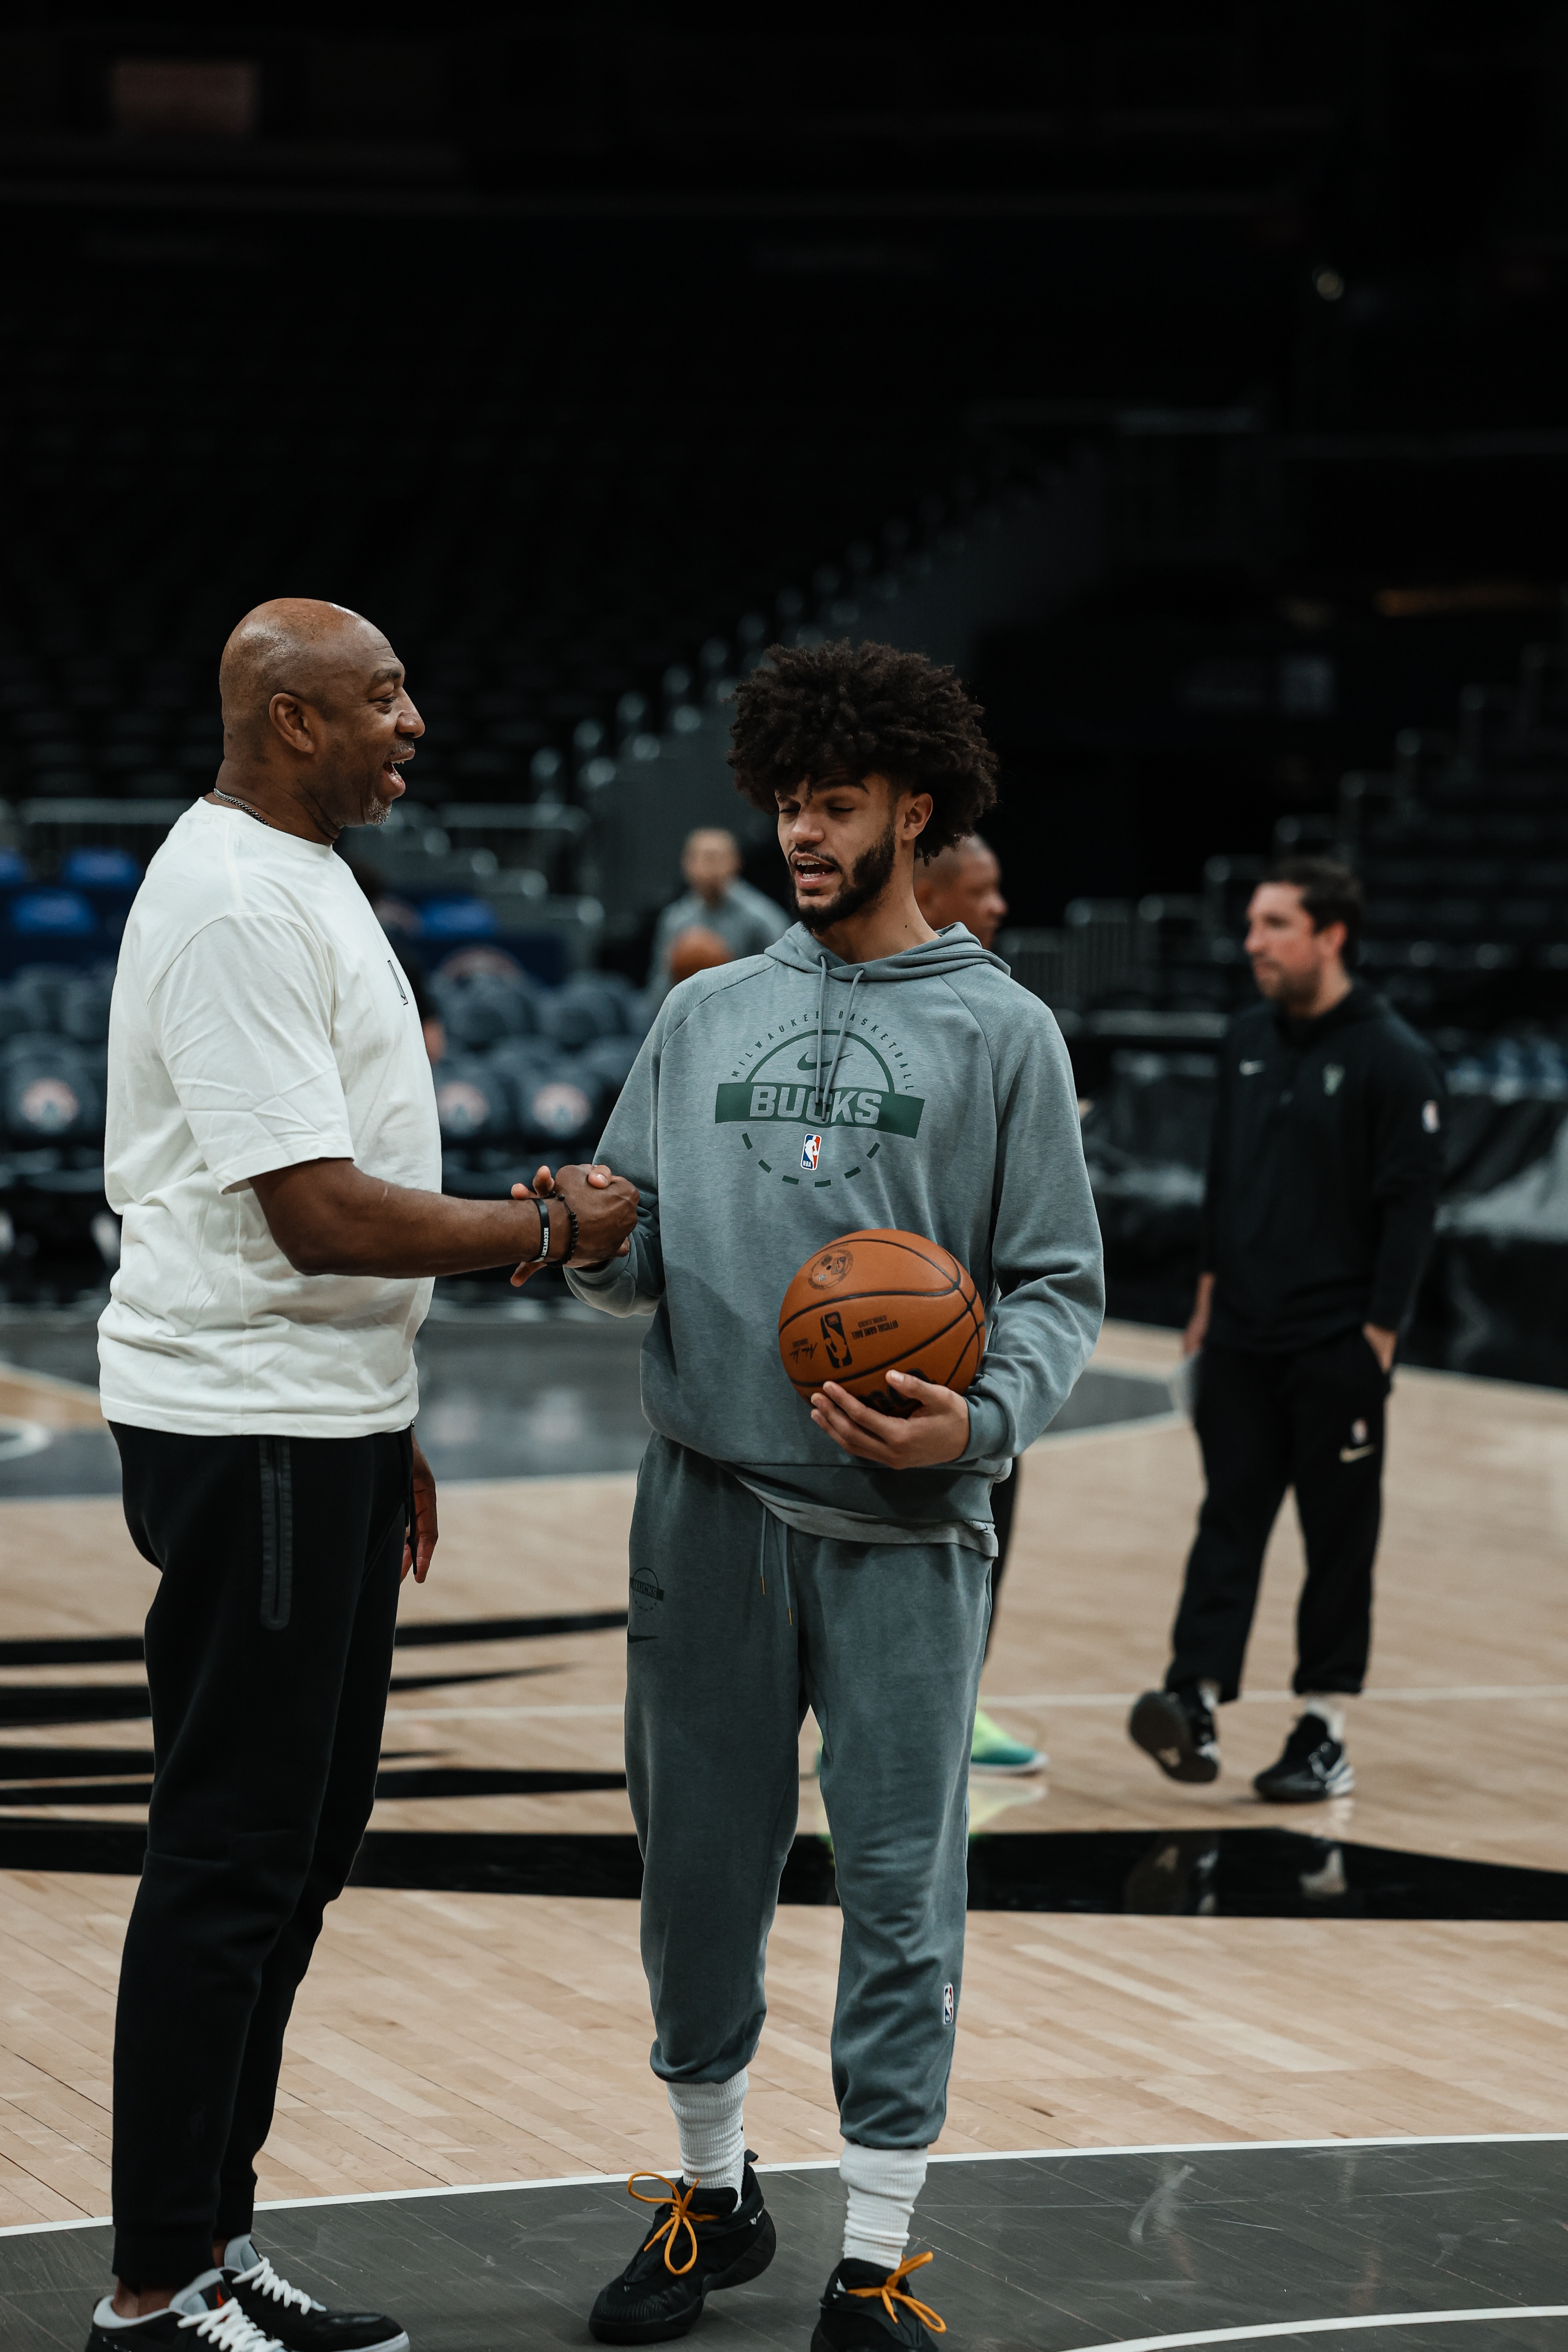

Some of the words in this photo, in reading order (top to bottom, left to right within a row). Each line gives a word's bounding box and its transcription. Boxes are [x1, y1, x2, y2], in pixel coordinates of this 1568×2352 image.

[838, 1011, 914, 1090] BASKETBALL
[750, 1085, 882, 1124] BUCKS
[633, 1580, 657, 1598] BUCKS
